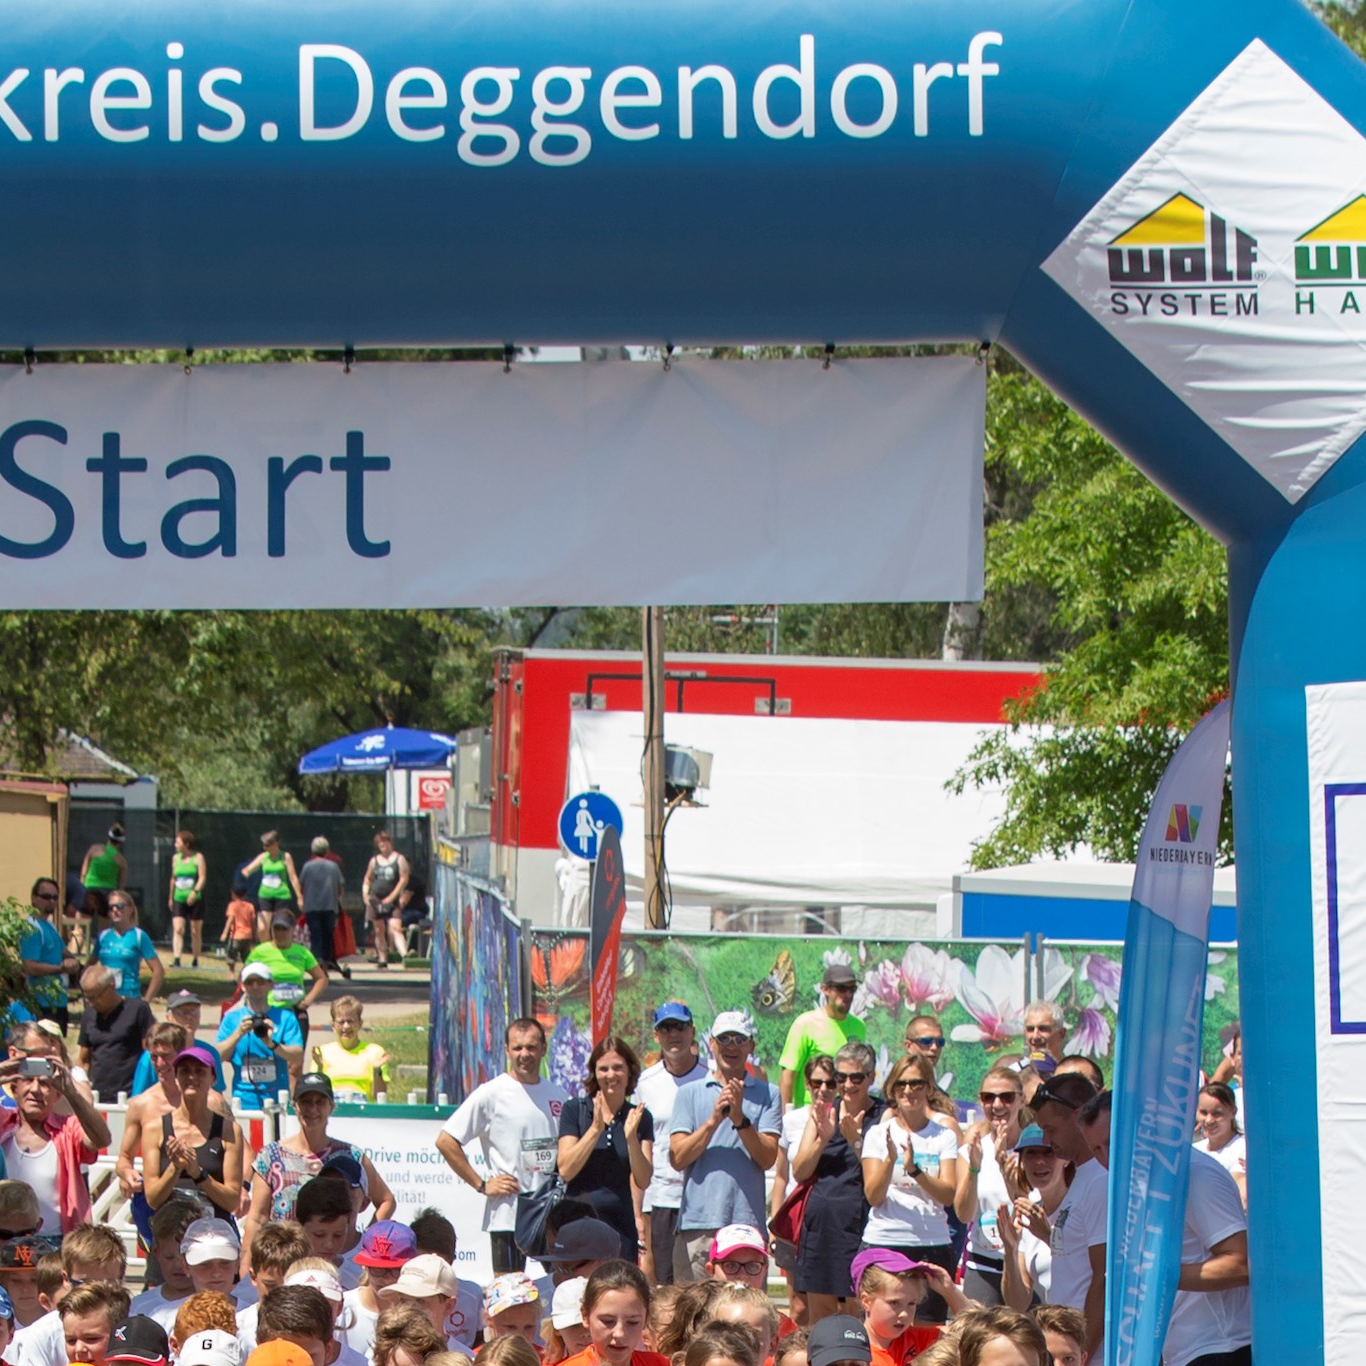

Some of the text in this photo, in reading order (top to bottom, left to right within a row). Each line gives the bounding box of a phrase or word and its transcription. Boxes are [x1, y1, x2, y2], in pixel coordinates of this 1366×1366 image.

[1107, 211, 1258, 282] wolf
[1110, 292, 1259, 316] SYSTEM
[1149, 847, 1213, 867] NIEDERBAYERN
[360, 1147, 402, 1164] Drive
[535, 1151, 552, 1162] 169
[386, 1171, 410, 1183] und
[414, 1171, 453, 1183] werde
[395, 1191, 426, 1204] lität!
[201, 1338, 213, 1350] G
